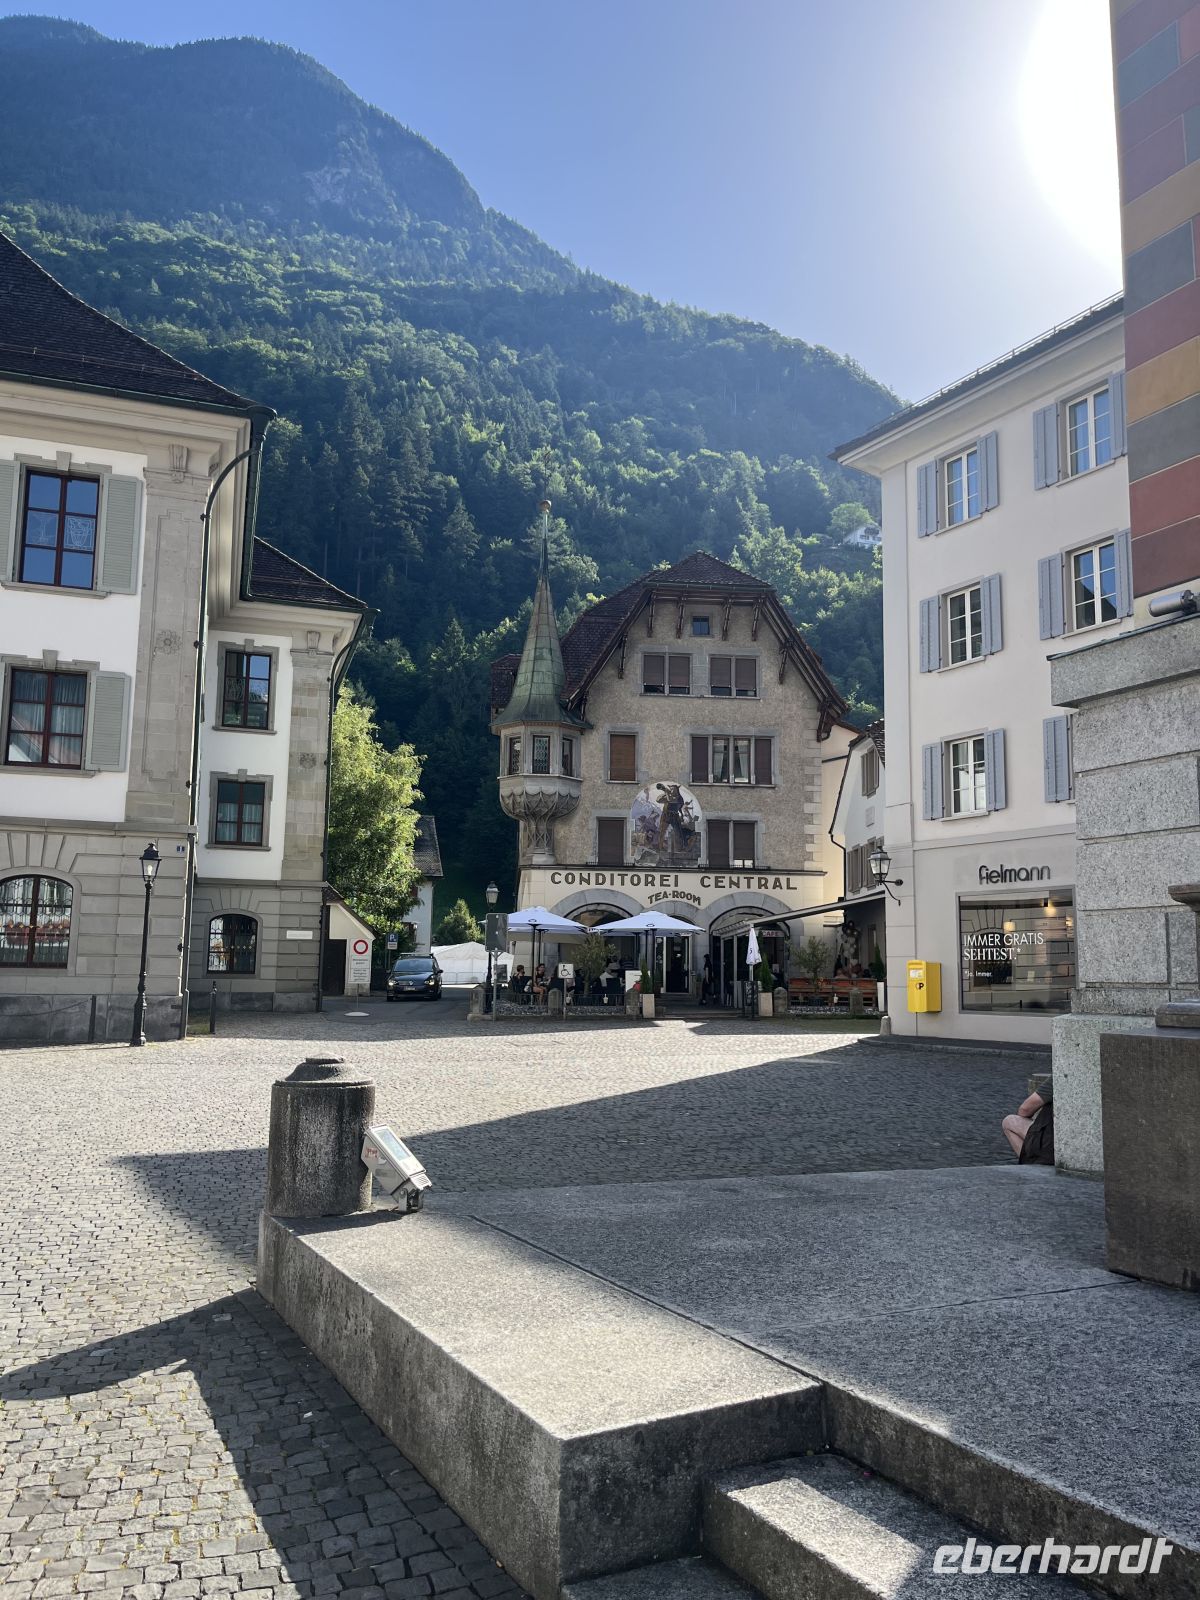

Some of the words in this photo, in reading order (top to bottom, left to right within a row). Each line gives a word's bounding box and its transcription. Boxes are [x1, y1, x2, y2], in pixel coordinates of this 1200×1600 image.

[550, 871, 679, 888] CONDITOREI
[699, 875, 798, 891] CENTRAL
[978, 864, 1051, 885] fielmann
[963, 934, 1001, 946] IMMER
